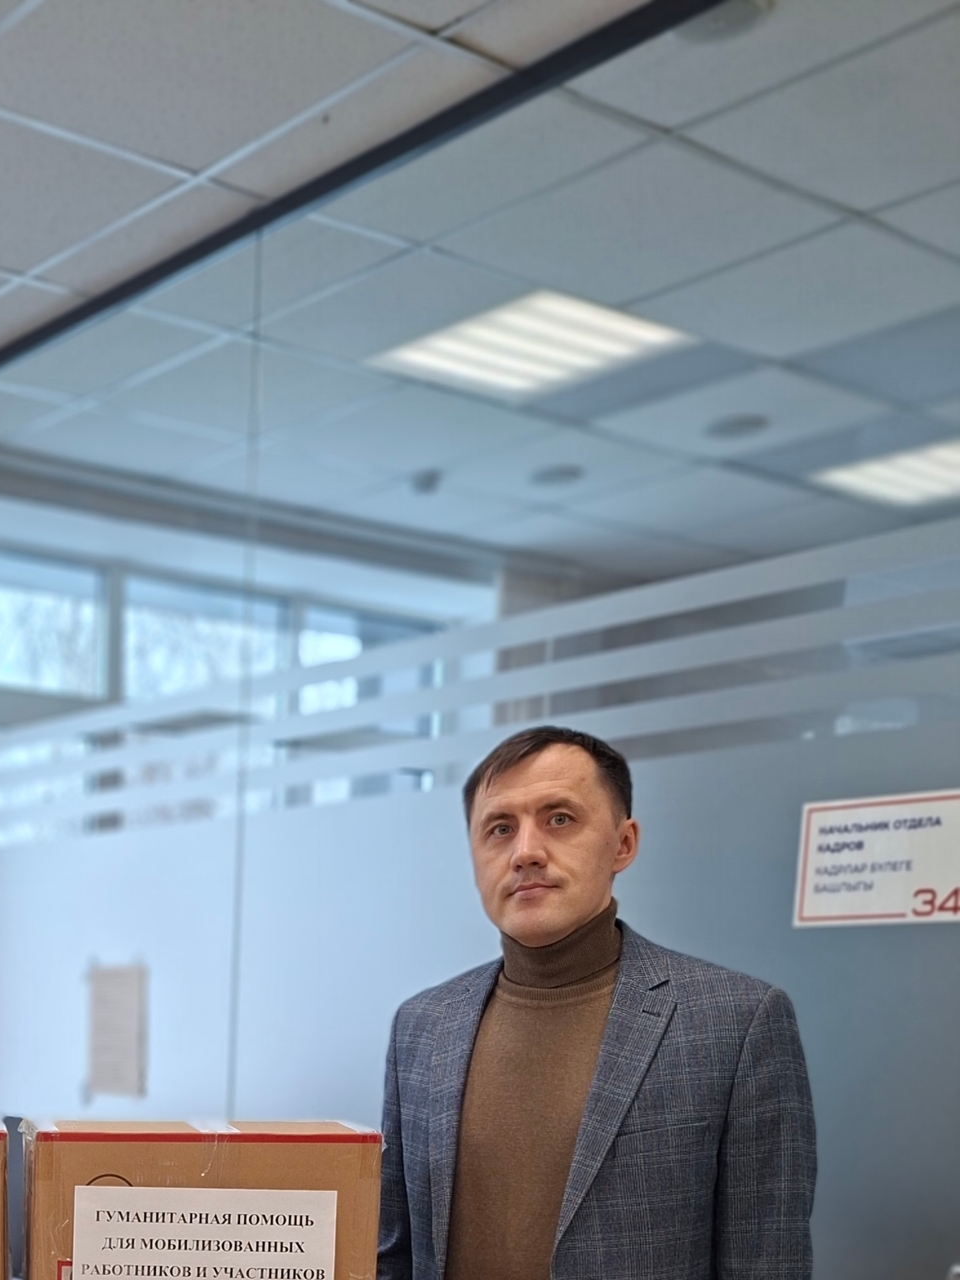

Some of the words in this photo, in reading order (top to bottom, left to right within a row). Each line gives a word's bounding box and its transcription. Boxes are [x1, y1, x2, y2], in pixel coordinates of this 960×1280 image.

[818, 820, 890, 836] НАЧАЛЬНИК
[893, 816, 942, 831] ОТДЕЛА
[817, 840, 865, 853] КАДРОВ
[95, 1209, 232, 1226] ГУМАНИТАРНАЯ
[236, 1213, 314, 1229] ПОМОЩЬ
[102, 1237, 136, 1251] ДЛЯ
[140, 1238, 306, 1254] МОБИЛИЗОВАННЫХ
[81, 1263, 192, 1278] РАБОТНИКОВ
[196, 1265, 208, 1279] И
